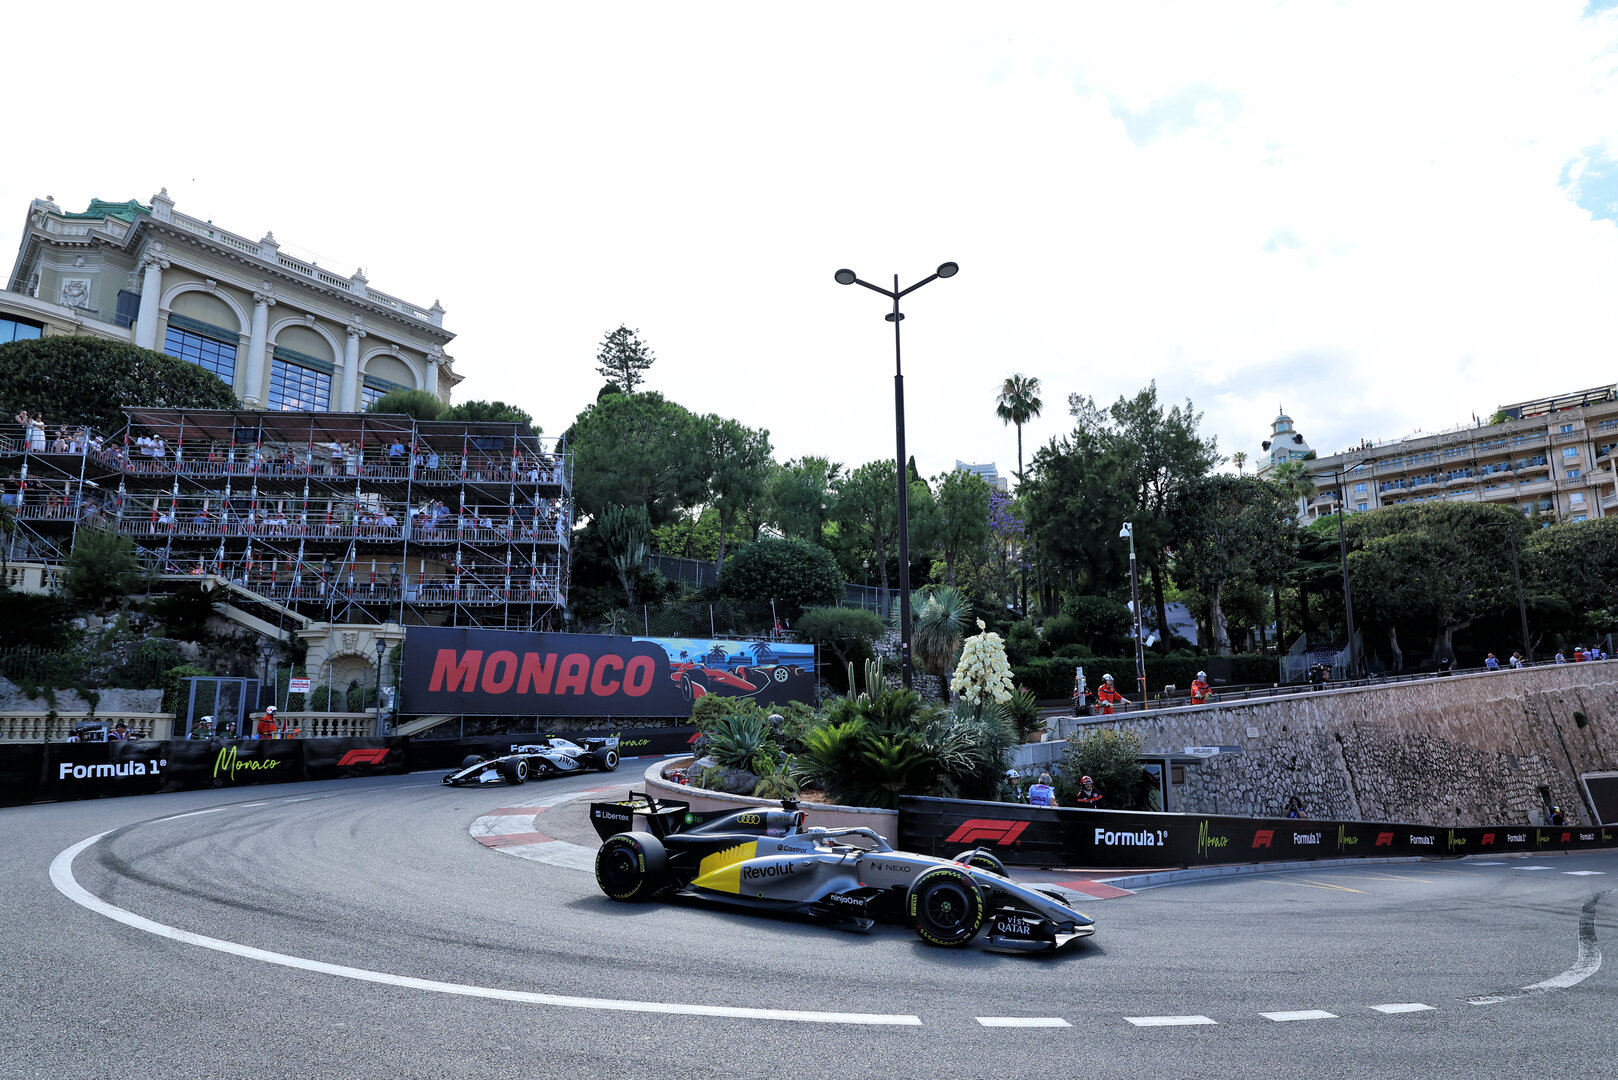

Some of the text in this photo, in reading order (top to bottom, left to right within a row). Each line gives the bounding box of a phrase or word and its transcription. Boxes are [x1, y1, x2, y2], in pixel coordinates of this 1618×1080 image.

[428, 649, 656, 697] MONACO
[213, 745, 281, 781] Monaco
[59, 760, 146, 780] Formula
[602, 810, 630, 821] Libertex
[694, 815, 703, 824] bp
[1094, 828, 1154, 846] Formula
[1198, 819, 1230, 859] Monaco
[1293, 832, 1315, 845] Formula
[1410, 834, 1430, 845] Formula
[783, 845, 807, 854] Castrol
[743, 861, 794, 880] Revolut
[885, 864, 911, 873] NEXO
[830, 894, 864, 906] ninjaOne
[997, 922, 1031, 935] QATAR
